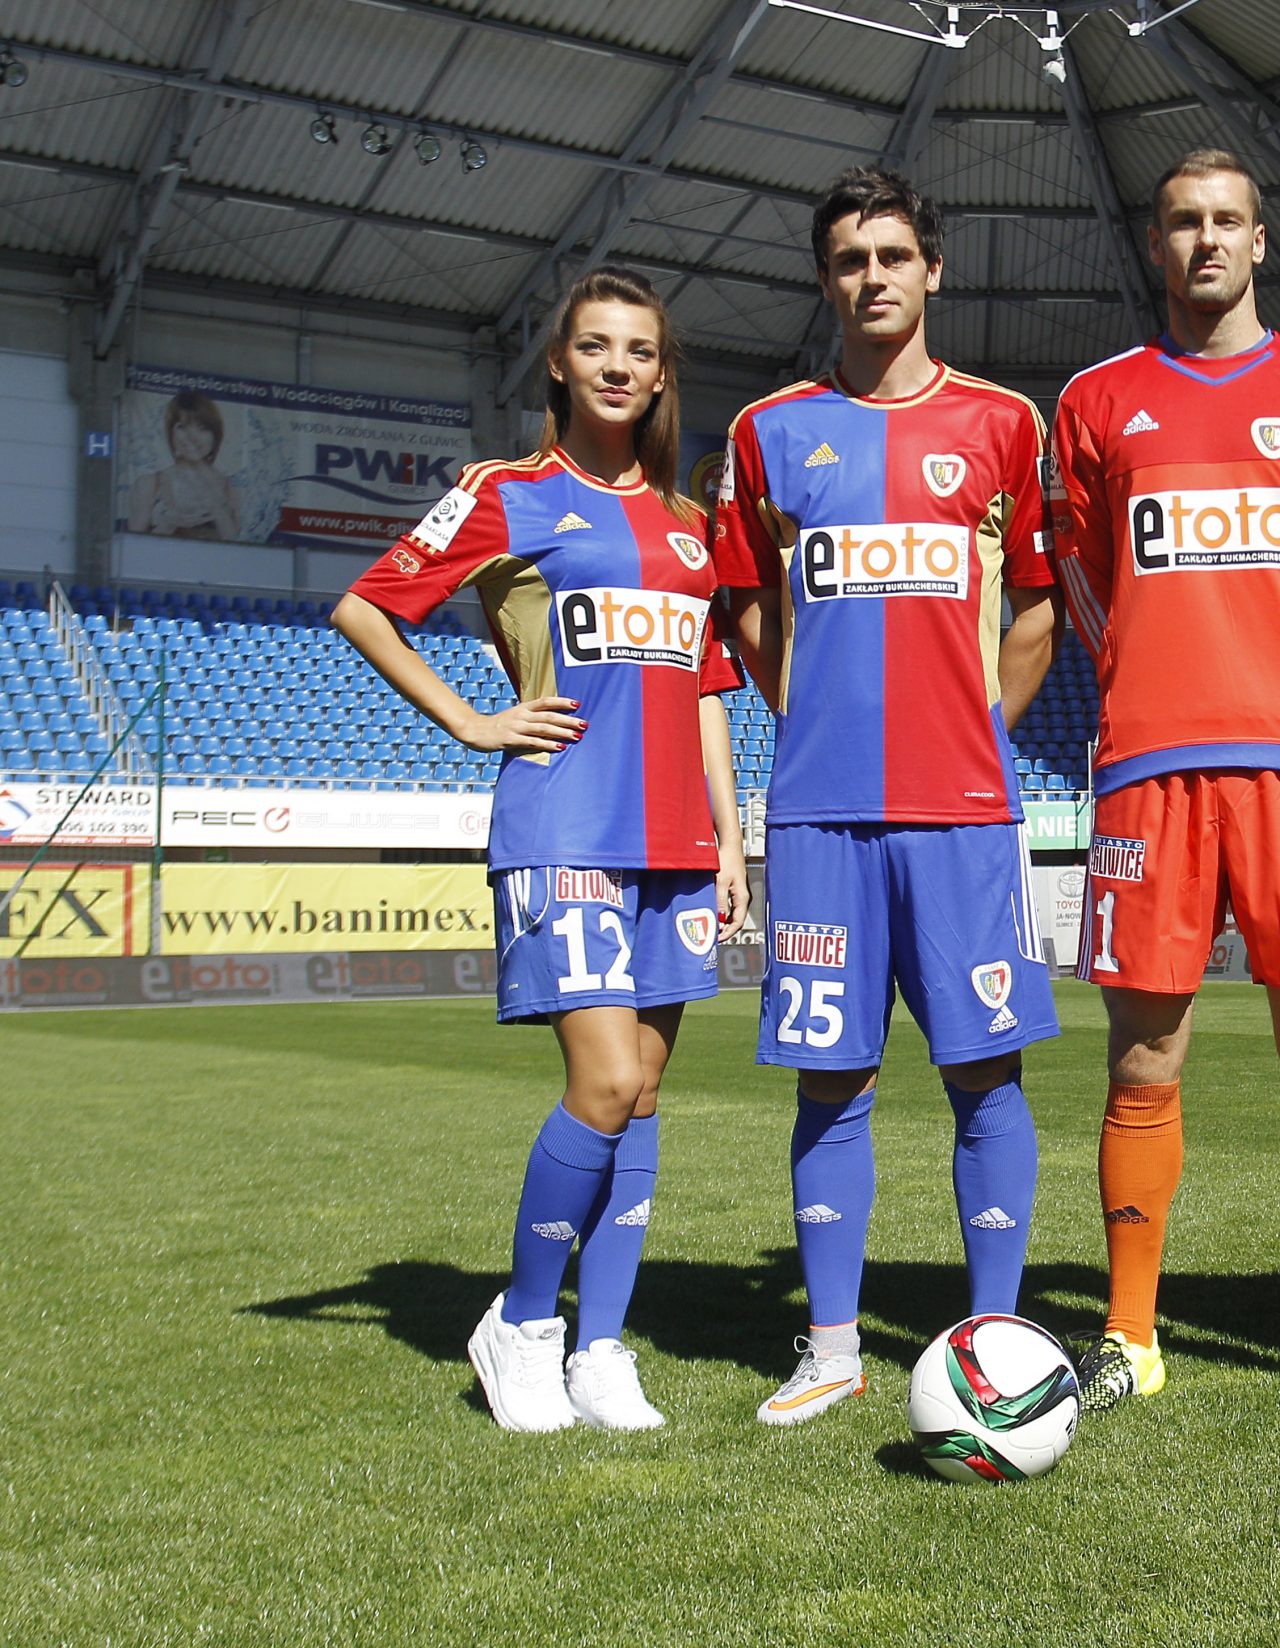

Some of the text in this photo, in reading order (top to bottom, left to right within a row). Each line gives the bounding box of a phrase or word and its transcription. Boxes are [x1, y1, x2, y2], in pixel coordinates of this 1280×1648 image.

[271, 385, 376, 411] Wodociągów
[388, 399, 471, 422] Kanalizacji
[88, 435, 110, 456] H
[1123, 420, 1160, 437] adidas
[315, 443, 457, 489] PWiK
[804, 454, 840, 469] adidas
[554, 520, 593, 534] adidas
[805, 526, 958, 598] etoto
[959, 535, 968, 589] SPONSOR
[1178, 553, 1219, 565] ZAKŁADY
[845, 582, 957, 594] ZAKŁADY BUKMACHERSKIE
[562, 591, 696, 662] etoto
[37, 789, 152, 806] STEWARD
[172, 810, 257, 825] PEC
[1092, 845, 1143, 880] GLIWICE
[778, 922, 843, 935] MIASTO
[1094, 891, 1120, 973] 1
[552, 907, 636, 994] 12
[776, 931, 844, 966] GLIWICE
[0, 960, 106, 994] toto
[141, 958, 270, 1000] etoto
[306, 953, 424, 994] etoto
[777, 976, 845, 1049] 25
[988, 1016, 1019, 1034] adidas
[969, 1217, 1017, 1230] adidas
